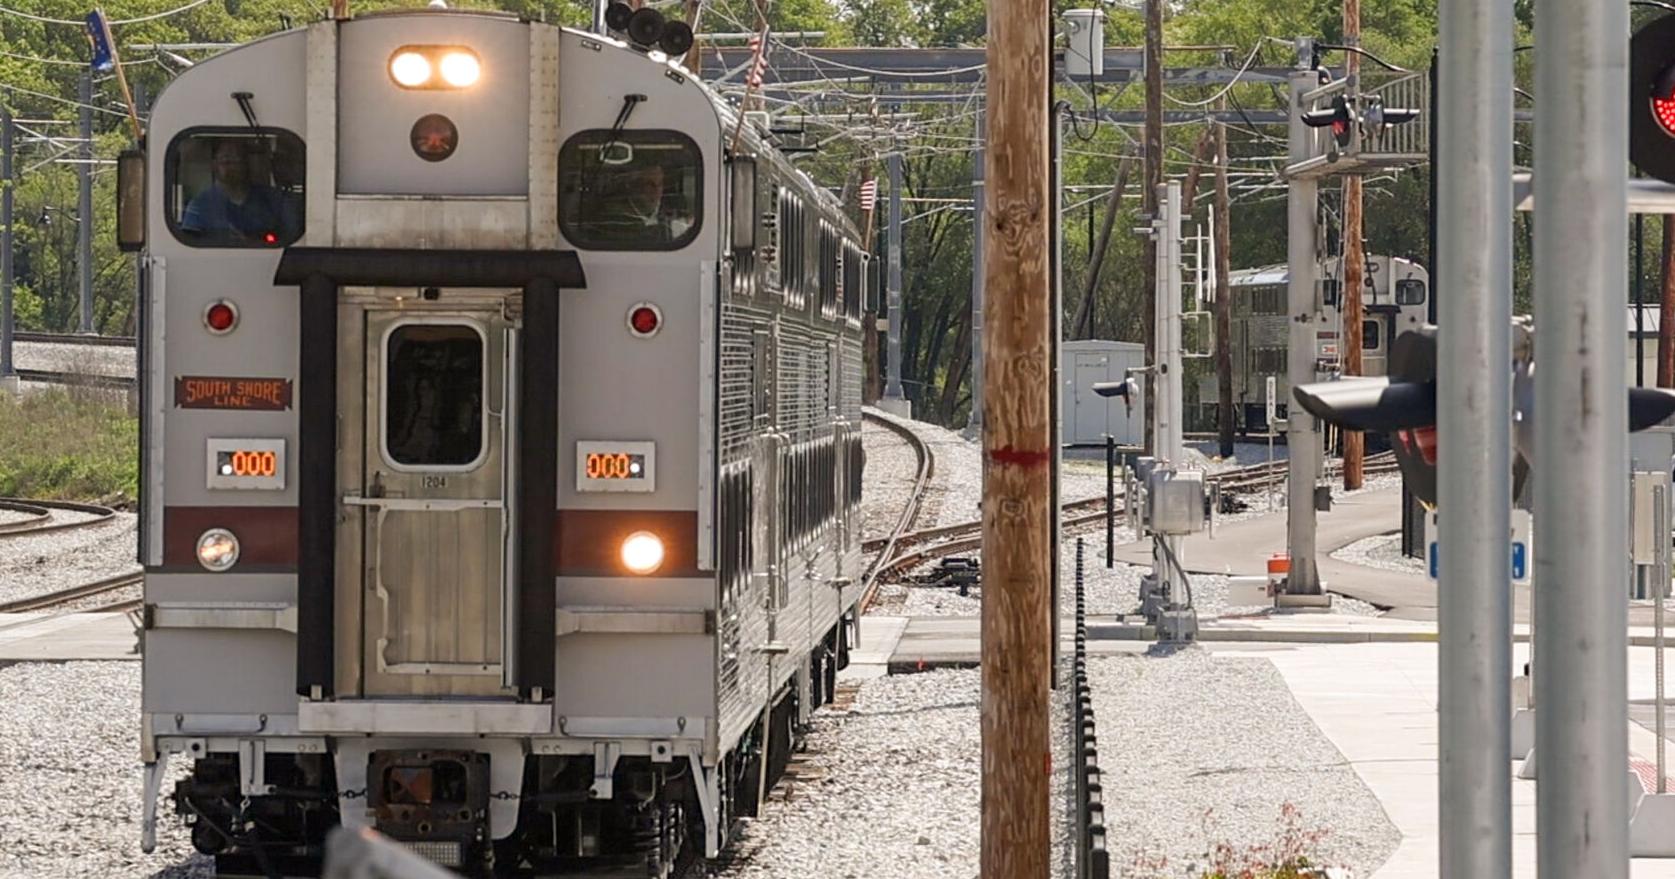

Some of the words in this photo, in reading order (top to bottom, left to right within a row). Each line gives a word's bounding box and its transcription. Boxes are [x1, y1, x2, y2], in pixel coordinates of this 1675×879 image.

[186, 380, 231, 402] SOUTH
[236, 382, 281, 404] SHORE
[214, 396, 251, 407] LINE
[233, 452, 275, 476] 000
[586, 453, 629, 478] 000
[422, 475, 446, 488] 1204
